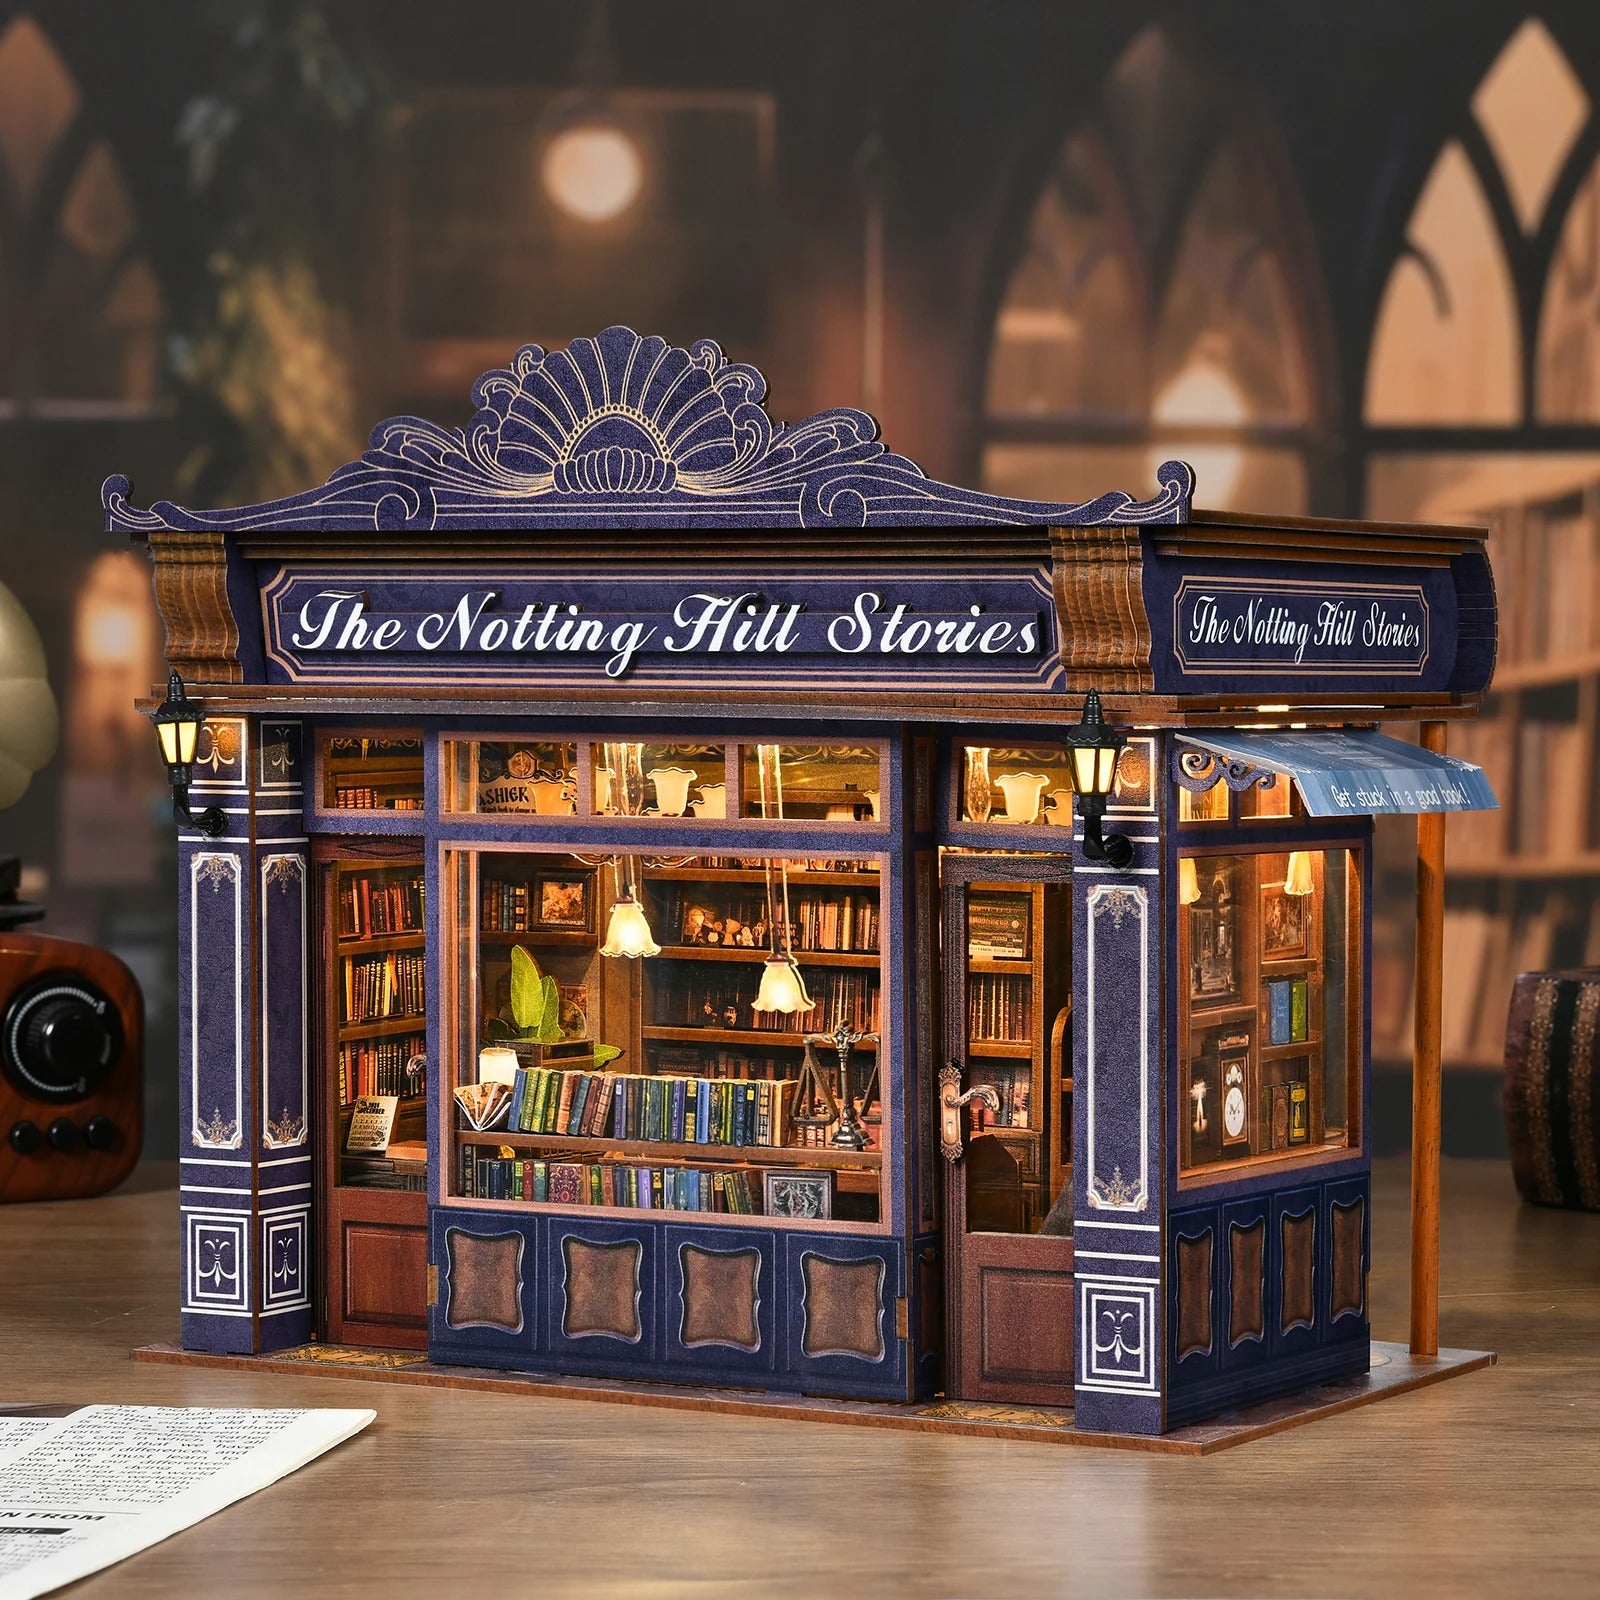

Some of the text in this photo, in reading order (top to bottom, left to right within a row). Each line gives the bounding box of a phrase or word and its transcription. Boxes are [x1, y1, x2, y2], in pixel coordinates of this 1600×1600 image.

[292, 591, 1036, 677] The Notting Hill Stories
[1189, 596, 1420, 665] The Notting Hill Stories
[1330, 782, 1471, 809] Get stuck in a good book!
[25, 1512, 106, 1520] FROM
